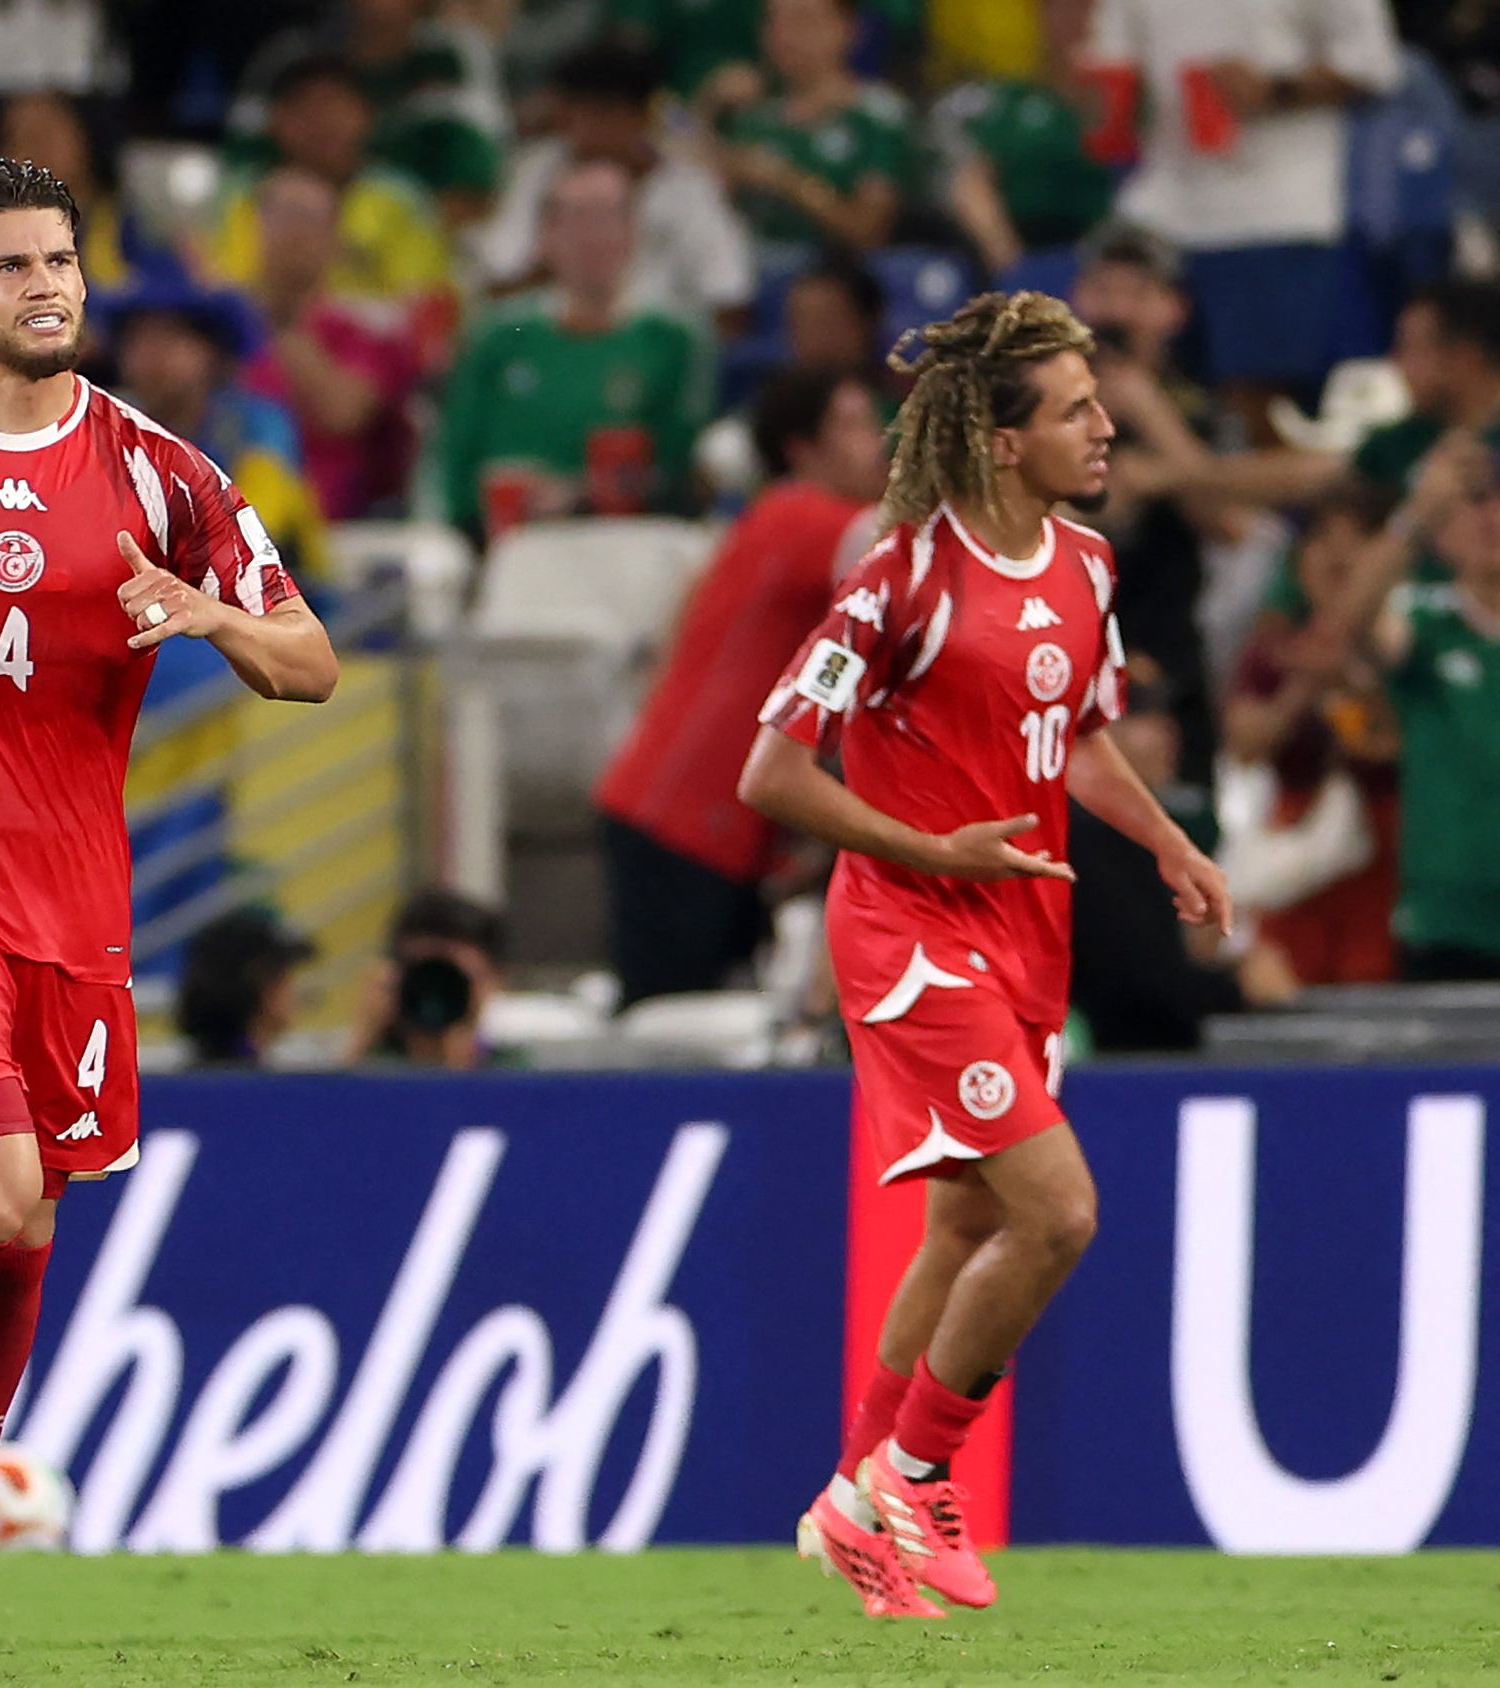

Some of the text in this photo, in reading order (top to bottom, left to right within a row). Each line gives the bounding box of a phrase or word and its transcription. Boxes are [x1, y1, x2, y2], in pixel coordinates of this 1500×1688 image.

[1020, 704, 1070, 783] 10
[77, 1019, 107, 1098] 4
[1170, 1095, 1485, 1555] U
